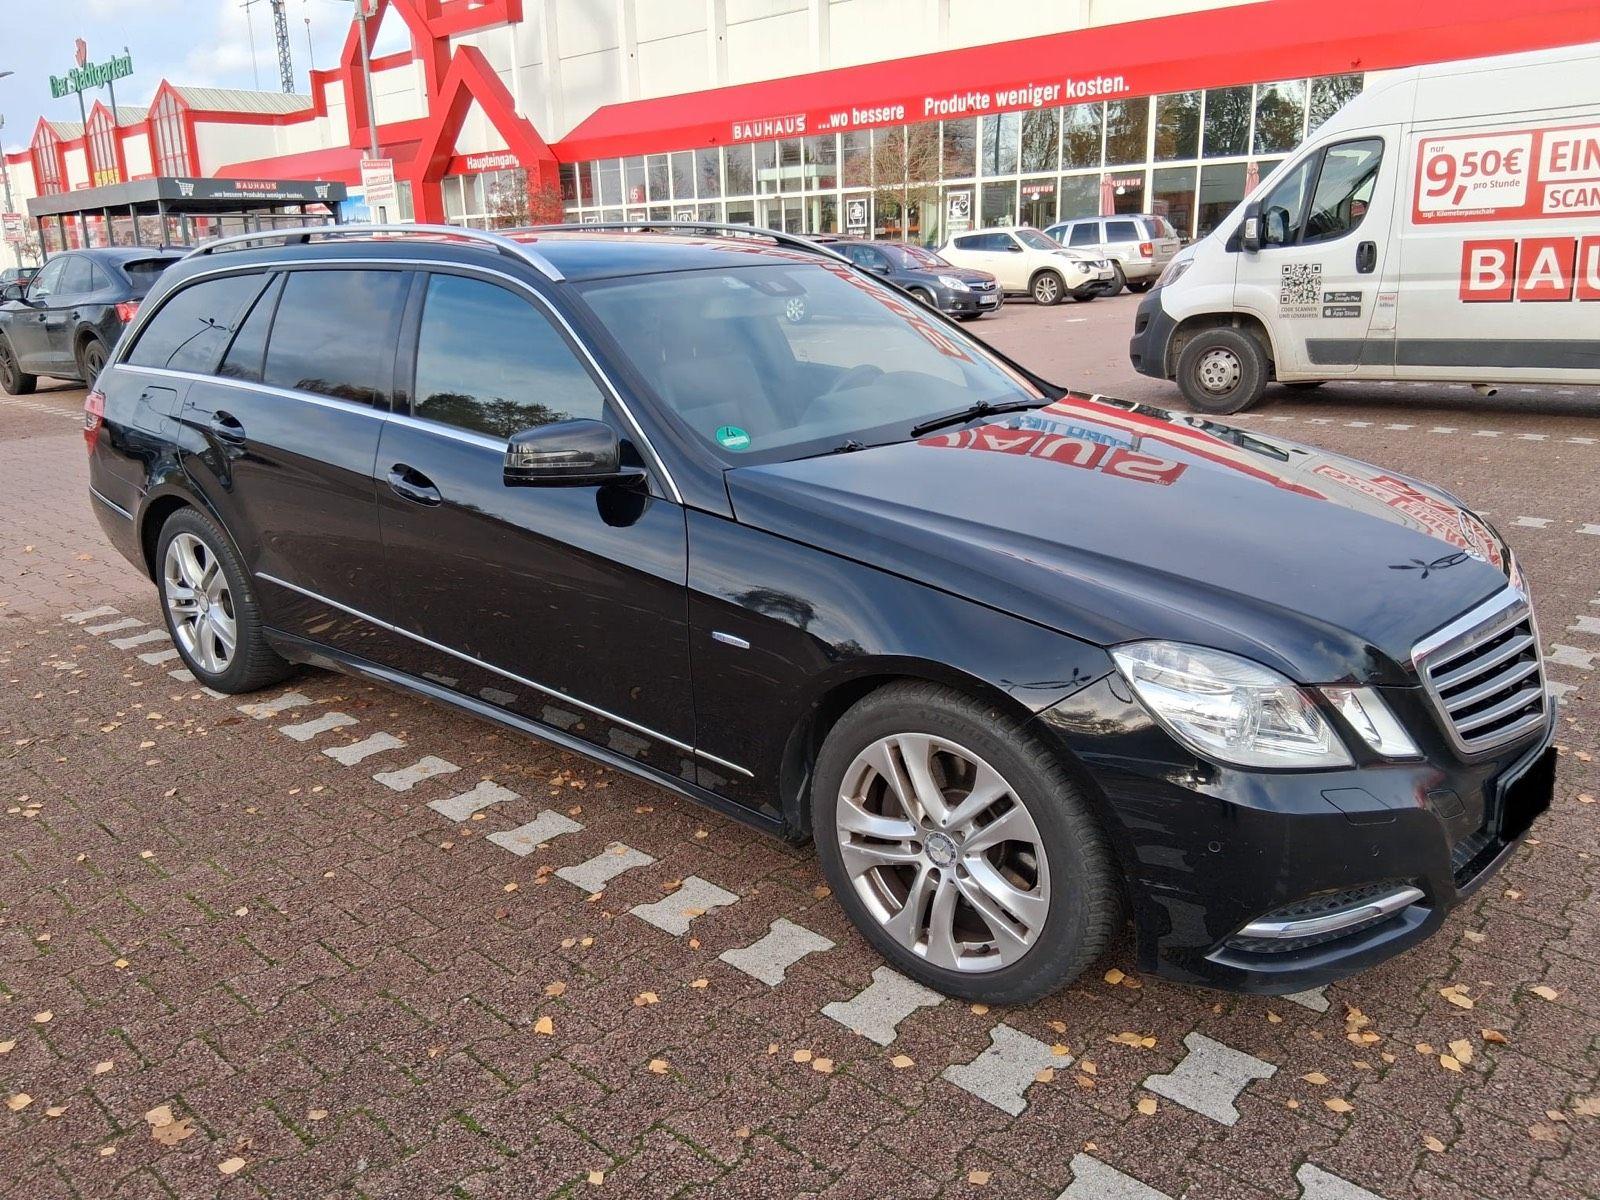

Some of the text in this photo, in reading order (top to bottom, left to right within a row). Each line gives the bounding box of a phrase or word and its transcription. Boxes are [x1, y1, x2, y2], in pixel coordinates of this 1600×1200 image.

[50, 56, 133, 98] Der Stadtgarten
[733, 115, 806, 141] BAUHAUS
[853, 105, 905, 125] bessere
[924, 92, 990, 116] Produkte
[996, 83, 1061, 107] weniger
[1066, 75, 1130, 98] kosten.
[1430, 145, 1445, 153] nur
[467, 153, 520, 171] Haupteingang
[235, 181, 277, 190] BAUHAUS
[1473, 179, 1520, 191] pro Stunde
